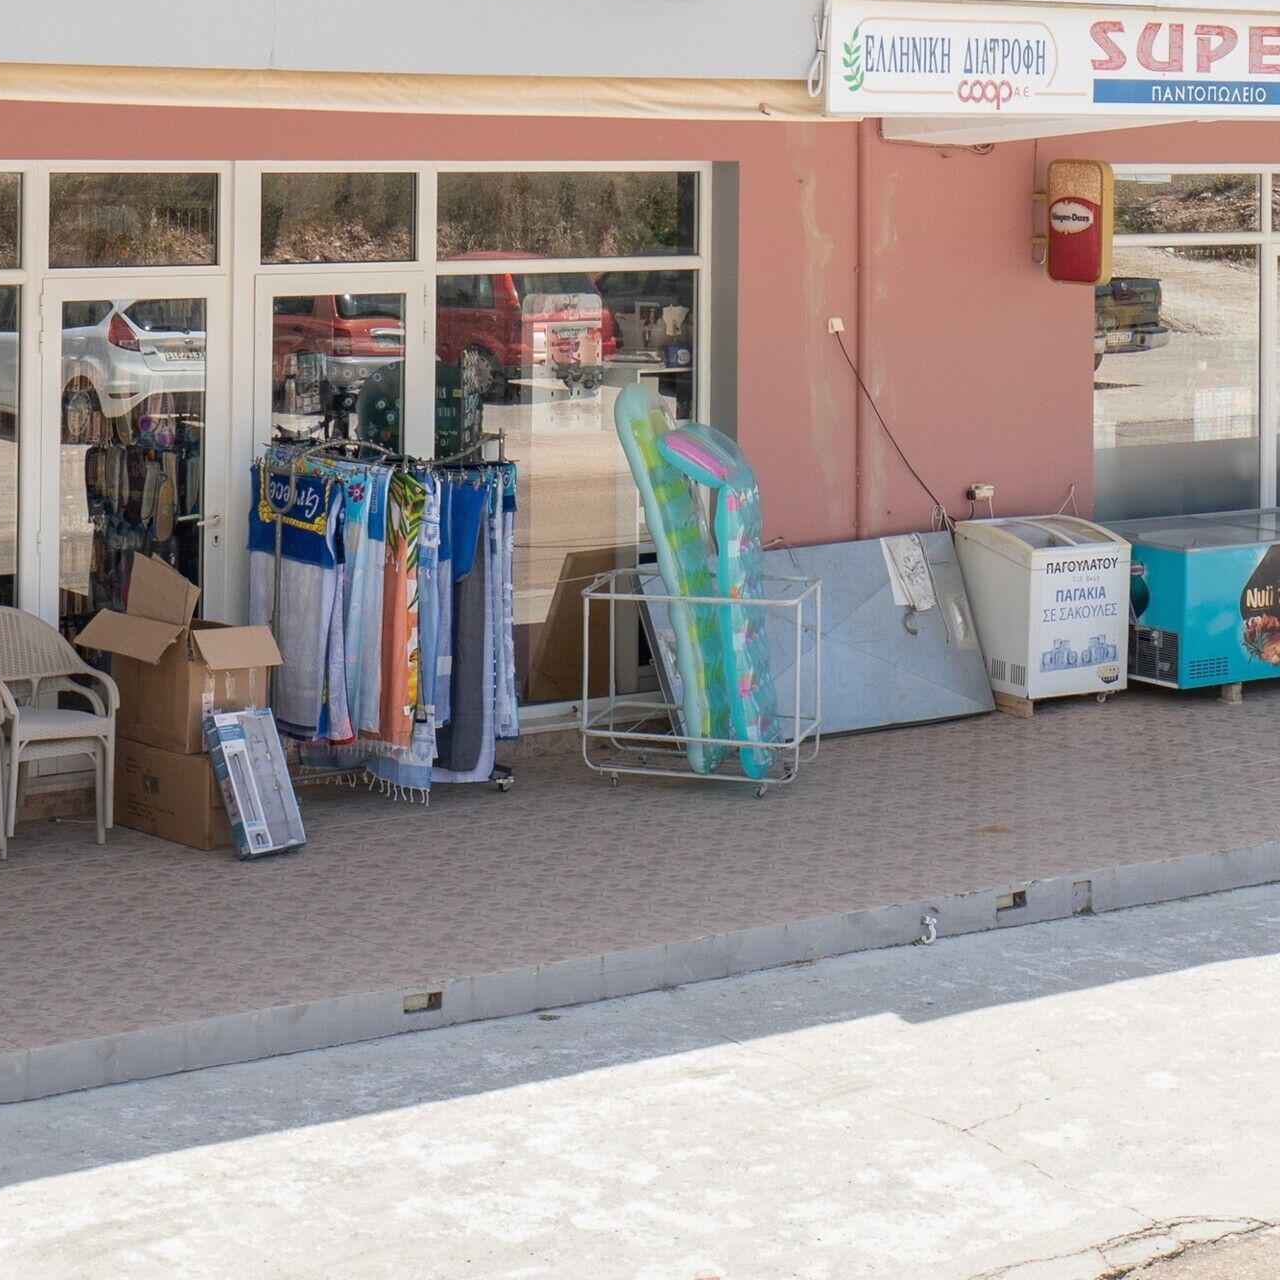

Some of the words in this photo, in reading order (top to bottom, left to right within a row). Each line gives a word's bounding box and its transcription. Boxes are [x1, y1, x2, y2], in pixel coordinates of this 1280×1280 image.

[865, 34, 951, 73] ΕΛΛΗΝΙΚΗ
[963, 37, 1046, 75] ΔΙΑΤΡΟΦΗ
[957, 79, 1013, 110] coop
[1152, 85, 1267, 102] ΠΑΝΤΟΠΩΛΕΙΟ
[1046, 557, 1119, 574] ΠΑΓΟΥΛΑΤΟΥ
[1056, 586, 1106, 603] ΠΑΓΑΚΙΑ
[1246, 586, 1274, 608] Nuii
[1043, 608, 1056, 622] ΣΕ
[1059, 602, 1118, 620] ΣΑΚΟΥΛΕΣ
